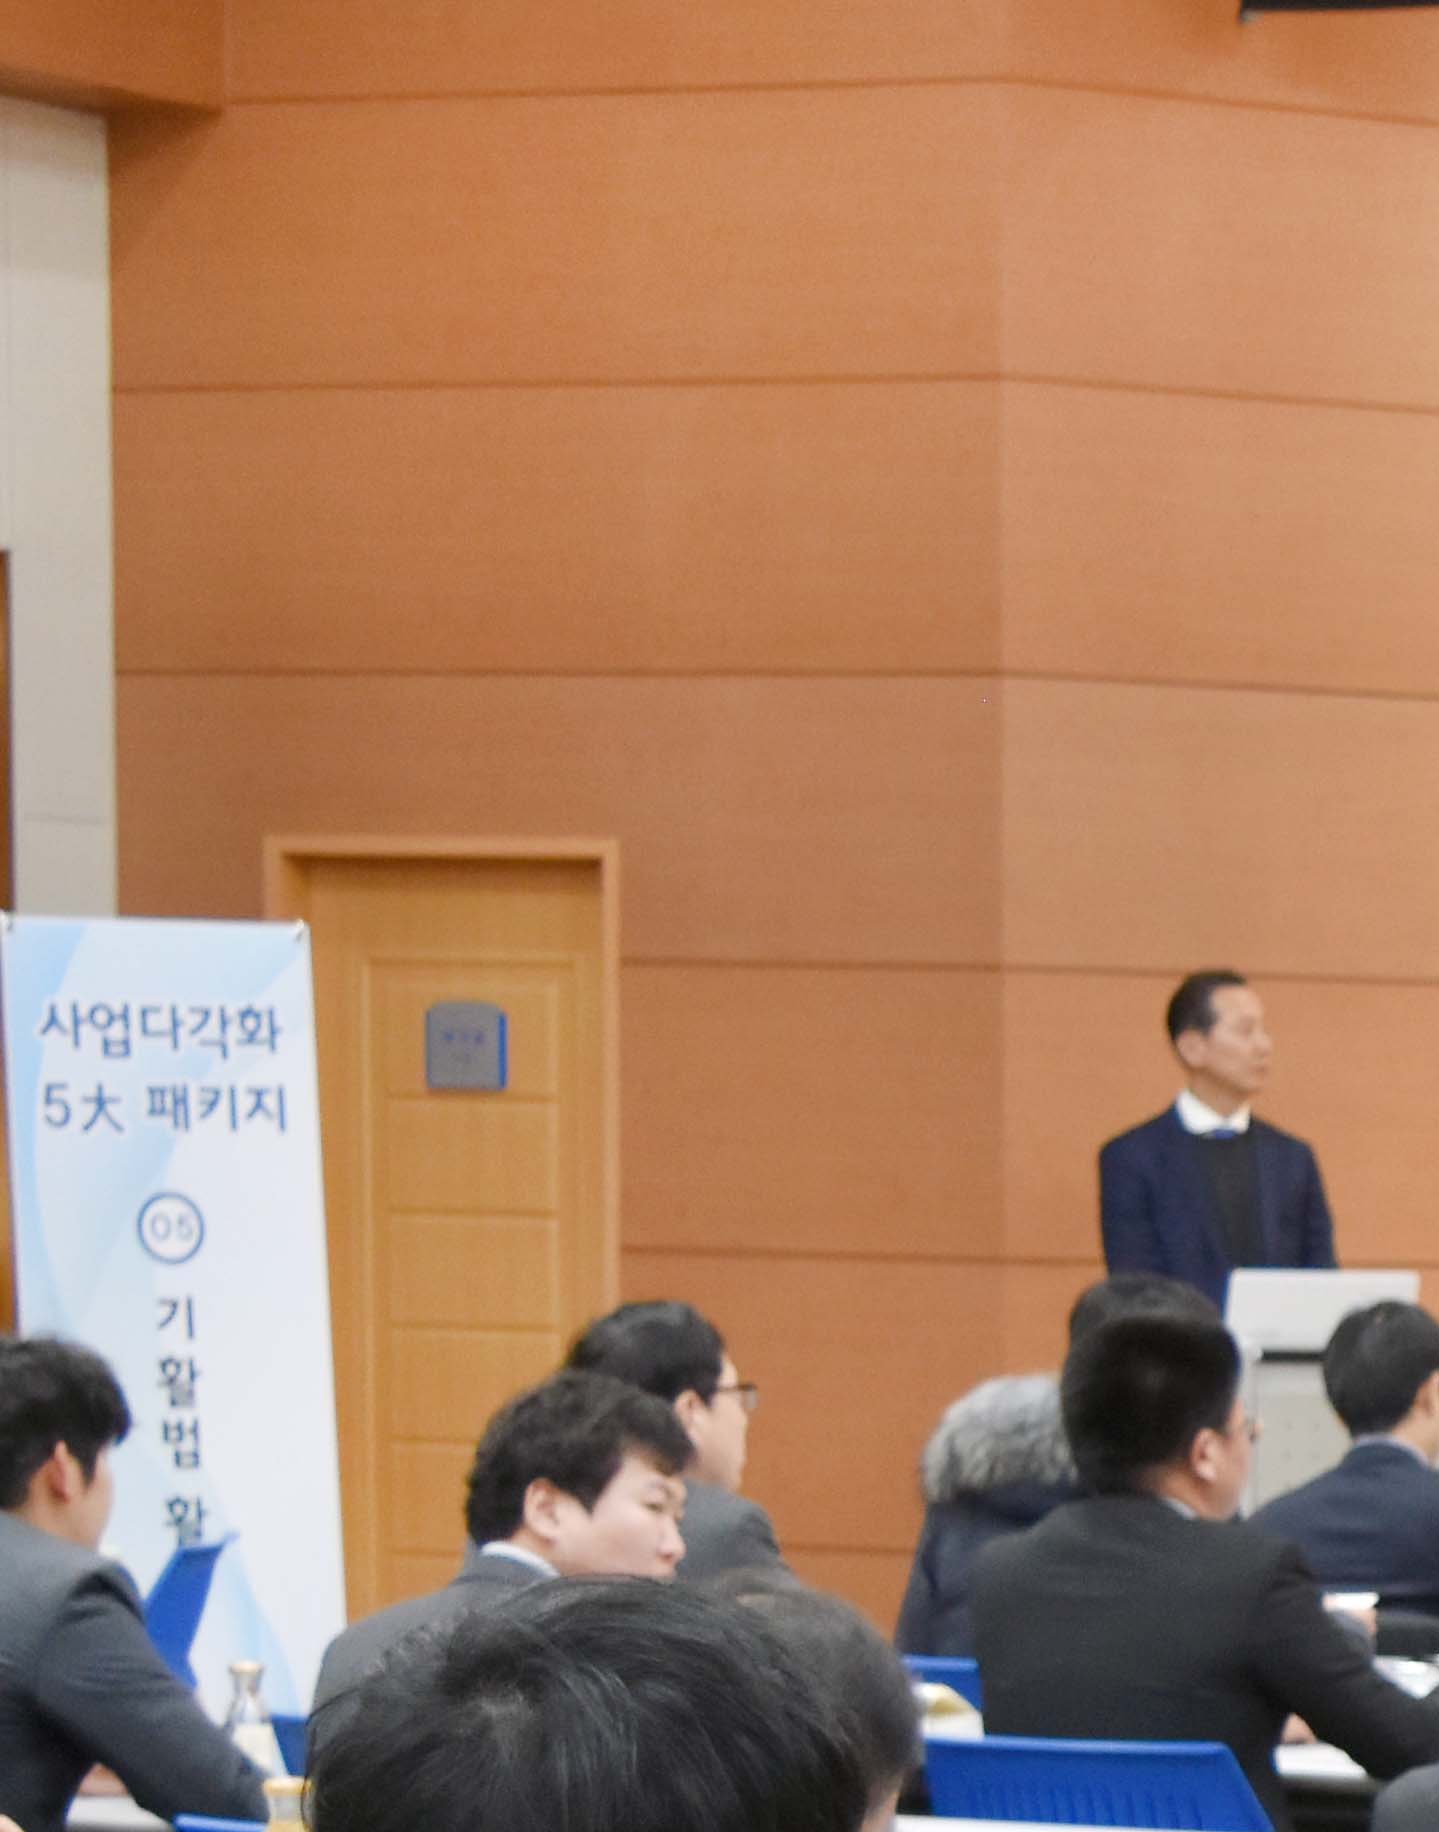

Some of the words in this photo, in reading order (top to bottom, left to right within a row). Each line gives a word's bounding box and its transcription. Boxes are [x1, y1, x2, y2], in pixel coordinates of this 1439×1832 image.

[40, 1002, 283, 1060] 사업다각화
[43, 1083, 124, 1133] 5大
[147, 1083, 287, 1133] 패키지
[150, 1212, 195, 1242] 05
